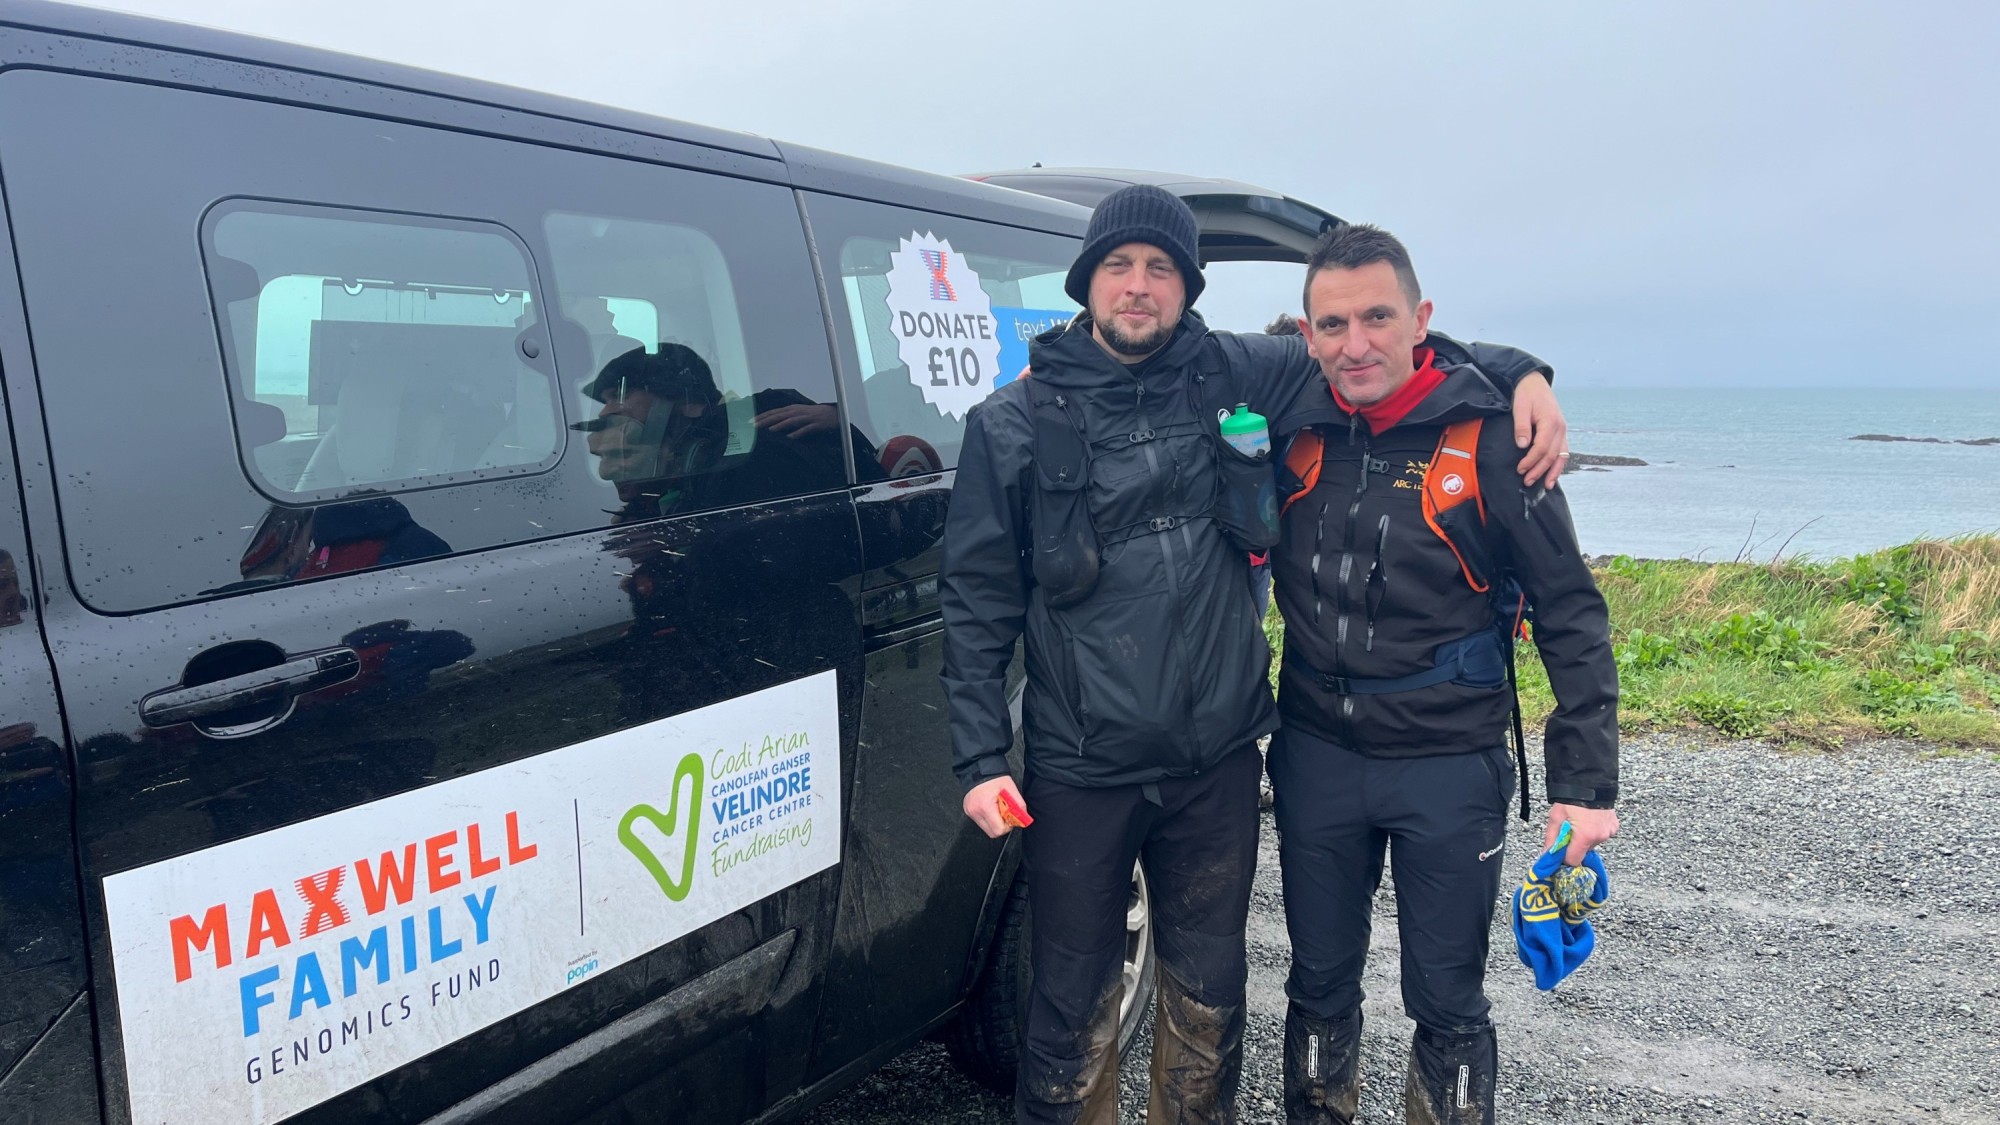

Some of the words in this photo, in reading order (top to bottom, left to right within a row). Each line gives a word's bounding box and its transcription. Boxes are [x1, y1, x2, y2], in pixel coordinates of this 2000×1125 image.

[899, 311, 991, 339] DONATE
[1014, 317, 1046, 341] text
[928, 346, 981, 387] £10
[711, 741, 753, 780] Codi
[758, 731, 810, 766] Arian
[711, 767, 768, 797] CANOLFAN
[771, 752, 811, 775] GANSER
[712, 767, 811, 825] VELINDRE
[713, 815, 763, 843] CANCER
[768, 794, 811, 821] CENTRE
[711, 818, 812, 878] Fundraising
[169, 811, 538, 983] MAXWELL
[239, 885, 497, 1038] FAMILY
[567, 958, 598, 985] popin
[246, 994, 412, 1085] GENOMICS
[432, 958, 500, 1007] FUND
